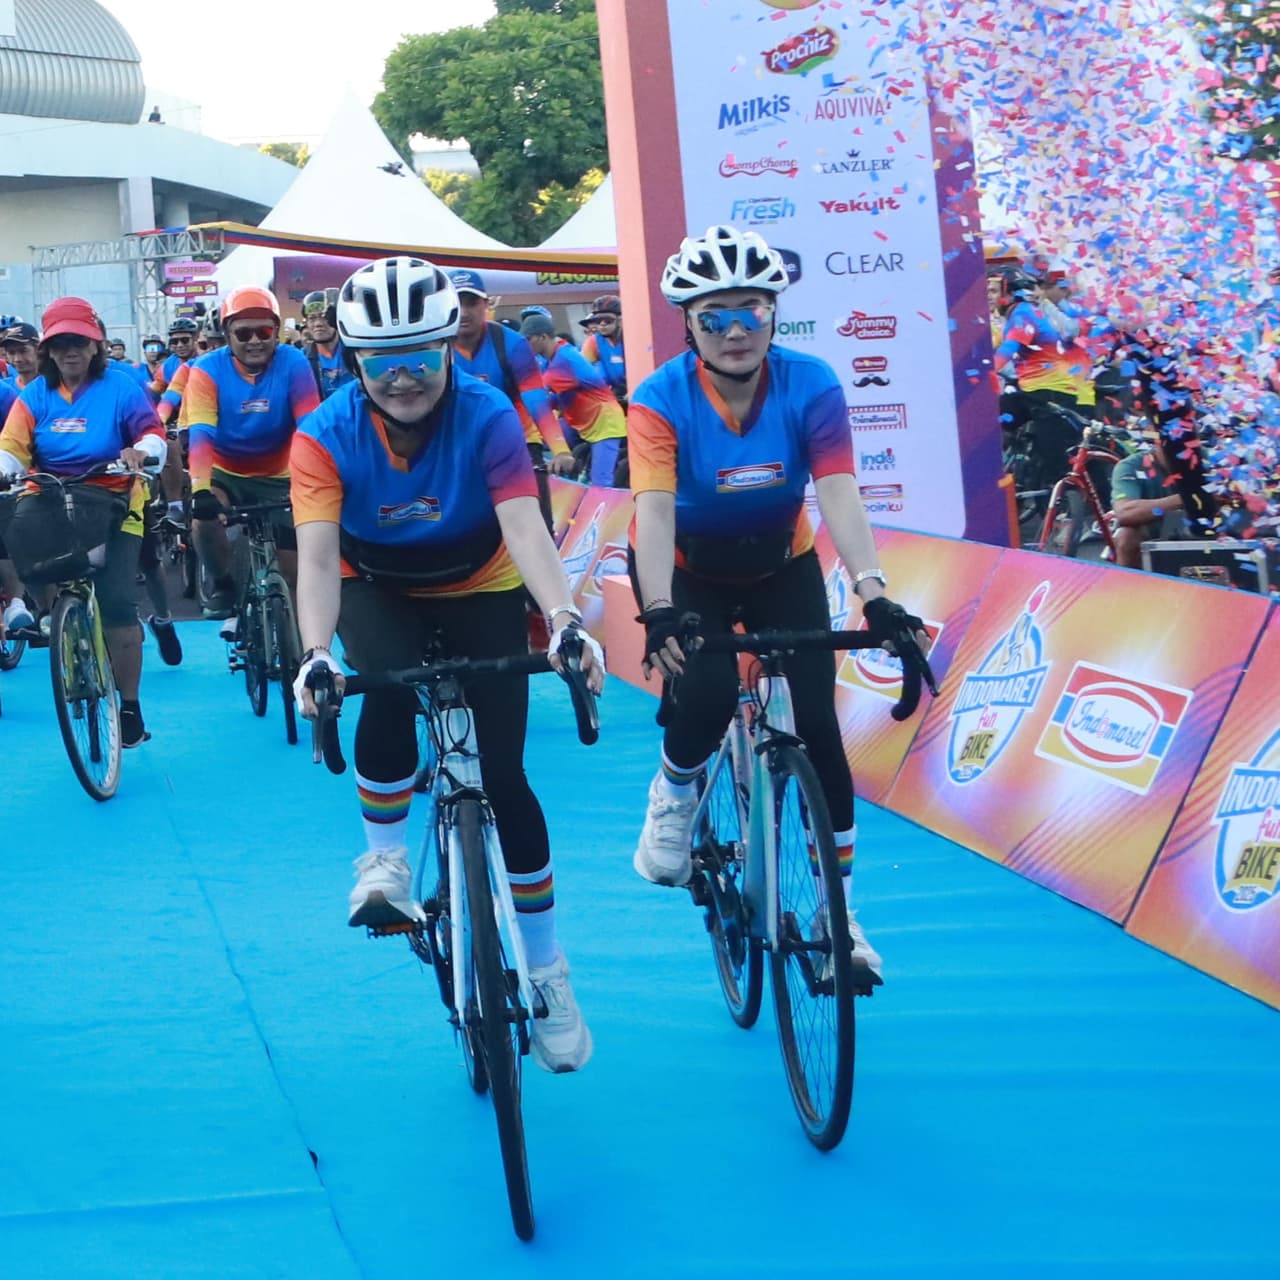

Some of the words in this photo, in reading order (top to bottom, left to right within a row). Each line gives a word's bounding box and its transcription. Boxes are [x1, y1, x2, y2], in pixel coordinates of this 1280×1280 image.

[718, 94, 790, 129] Milkis
[731, 197, 795, 220] Fresh
[819, 196, 900, 214] Yakult
[825, 251, 904, 275] CLEAR
[960, 732, 993, 760] BIKE
